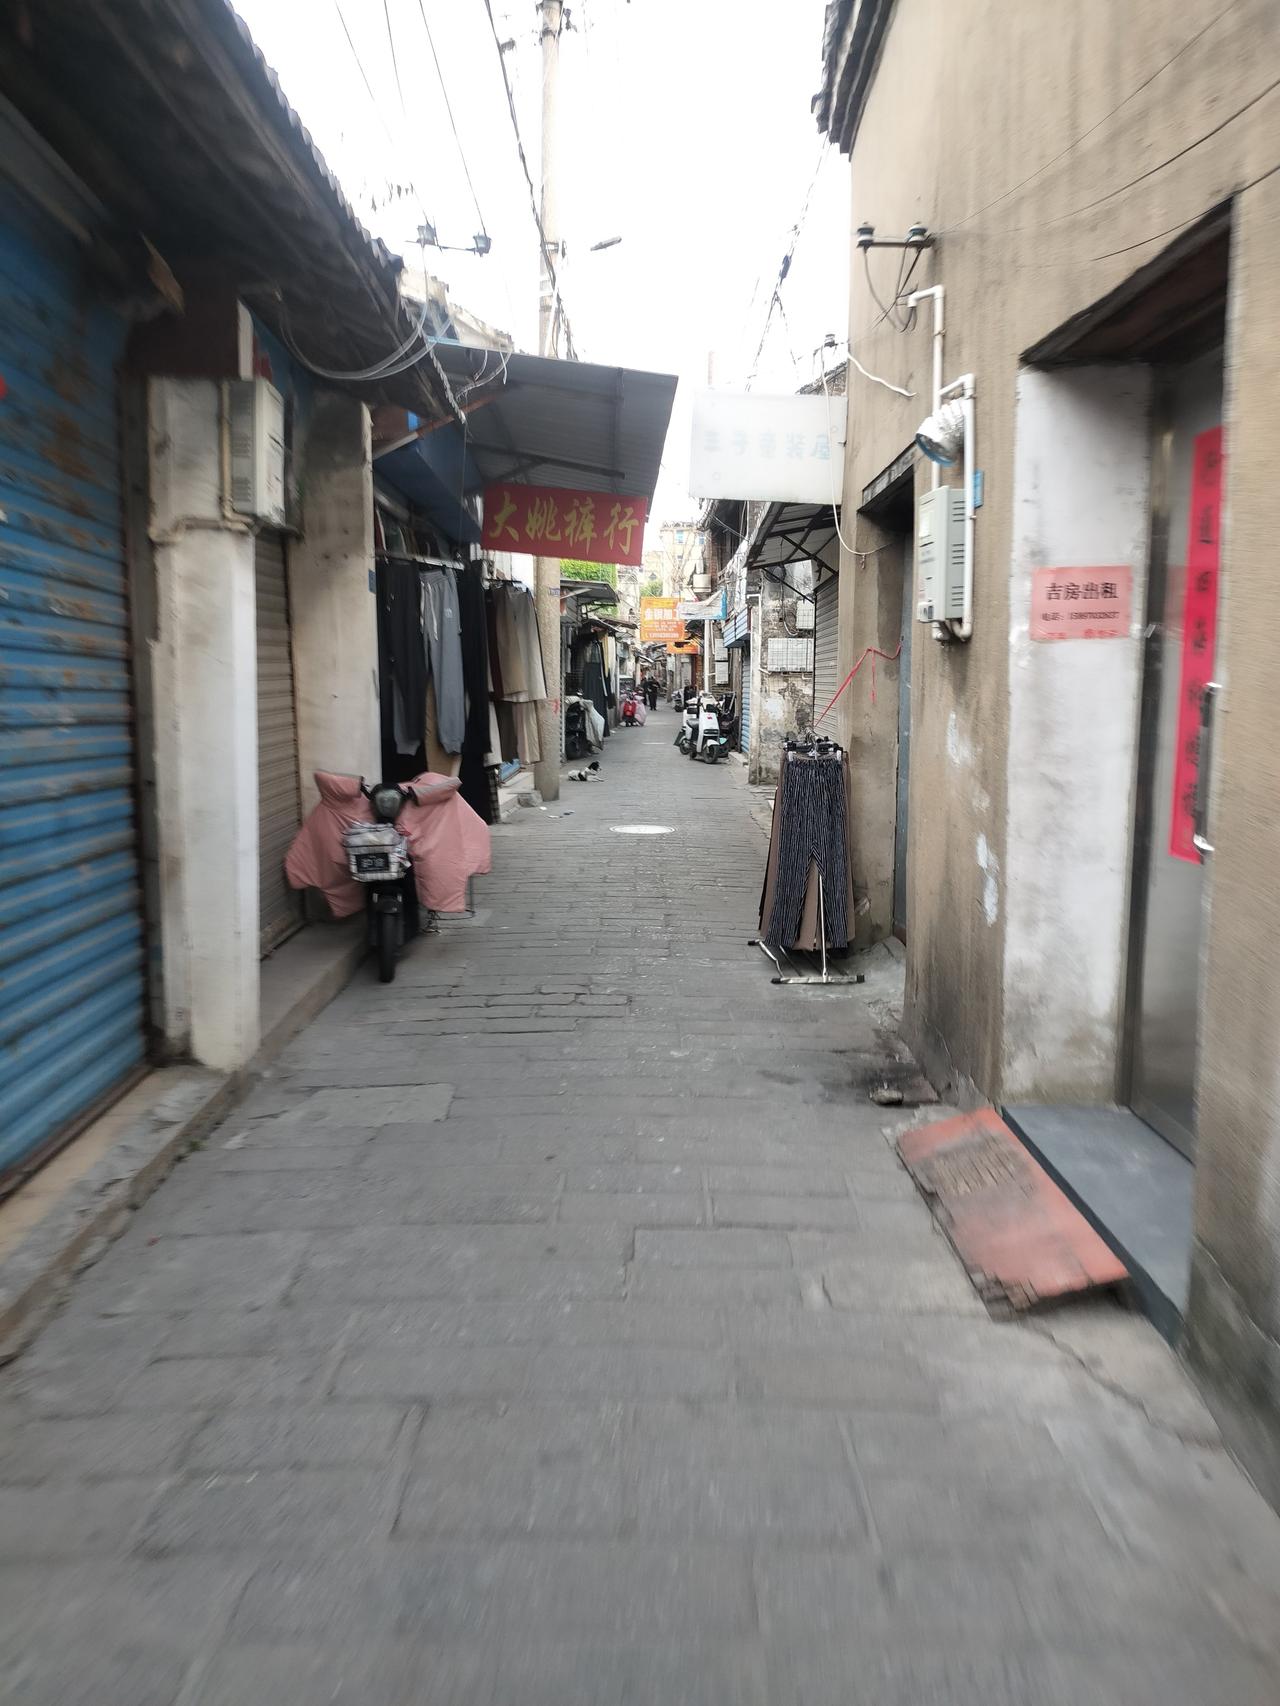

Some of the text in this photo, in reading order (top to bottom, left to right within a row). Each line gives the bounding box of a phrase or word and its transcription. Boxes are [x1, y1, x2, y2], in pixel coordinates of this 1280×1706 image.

[489, 491, 640, 556] 大姚裤行
[1046, 582, 1119, 601] 吉房出租
